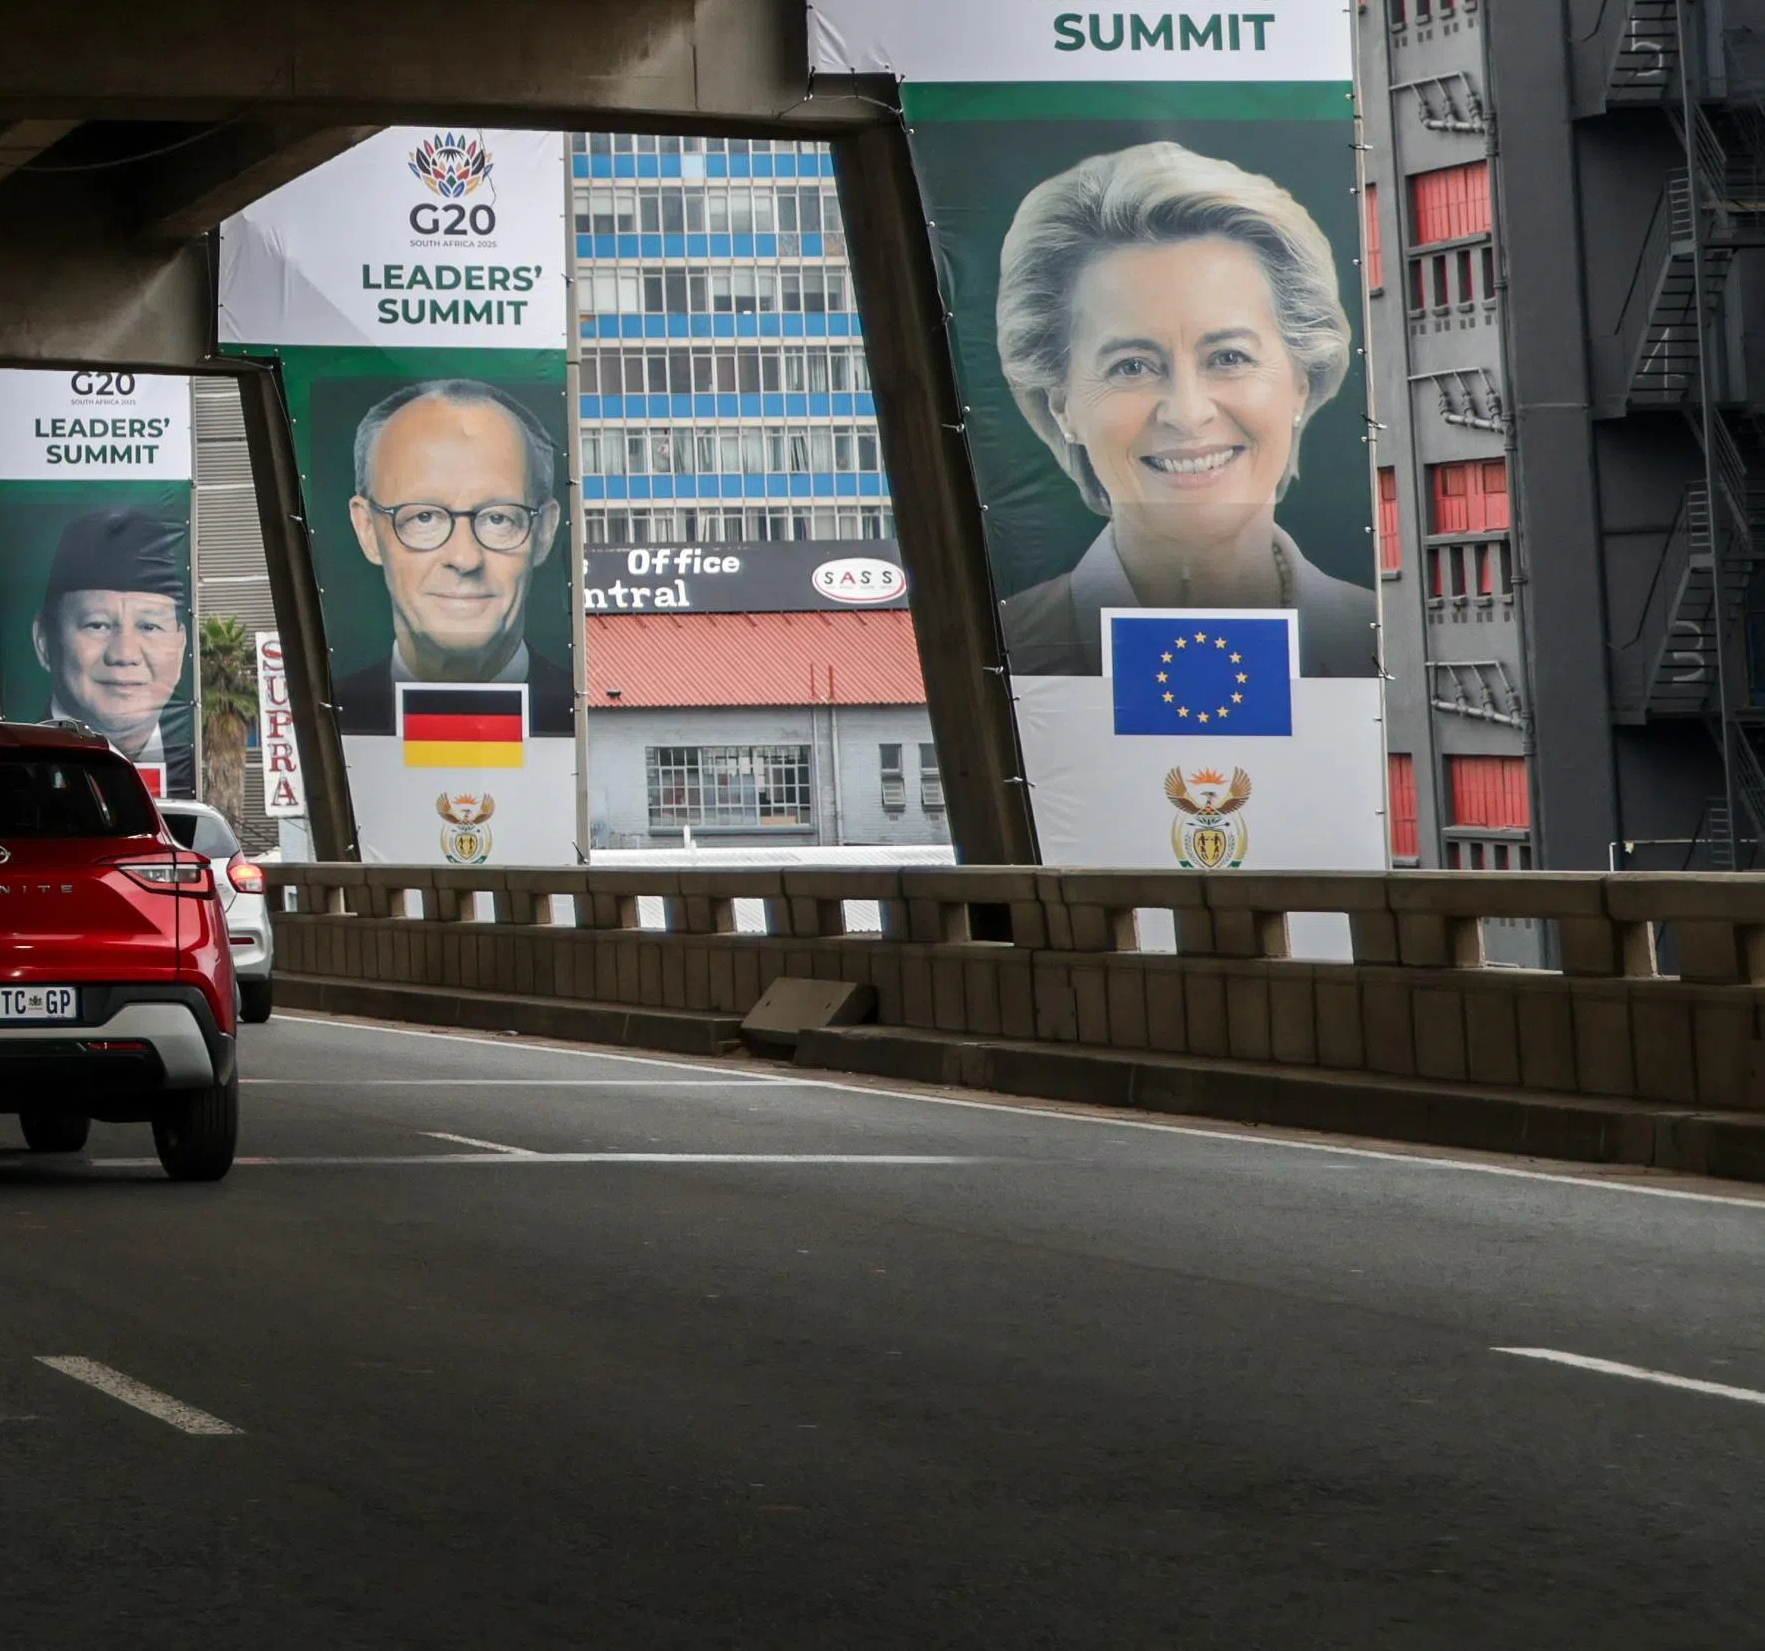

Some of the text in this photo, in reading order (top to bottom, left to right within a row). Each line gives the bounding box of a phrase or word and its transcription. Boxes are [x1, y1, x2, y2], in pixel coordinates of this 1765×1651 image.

[1053, 13, 1275, 51] SUMMIT
[409, 203, 496, 236] G20
[410, 239, 497, 248] SOUTH AFRICA 2025
[362, 264, 542, 292] LEADERS’
[377, 298, 528, 325] SUMMIT
[71, 371, 135, 396] G20
[71, 398, 137, 406] SOUTH AFRICA 2025
[35, 418, 170, 438] LEADERS’
[46, 444, 159, 465] SUMMIT
[627, 548, 741, 575] Office
[1, 990, 27, 1015] TC
[45, 989, 71, 1015] GP
